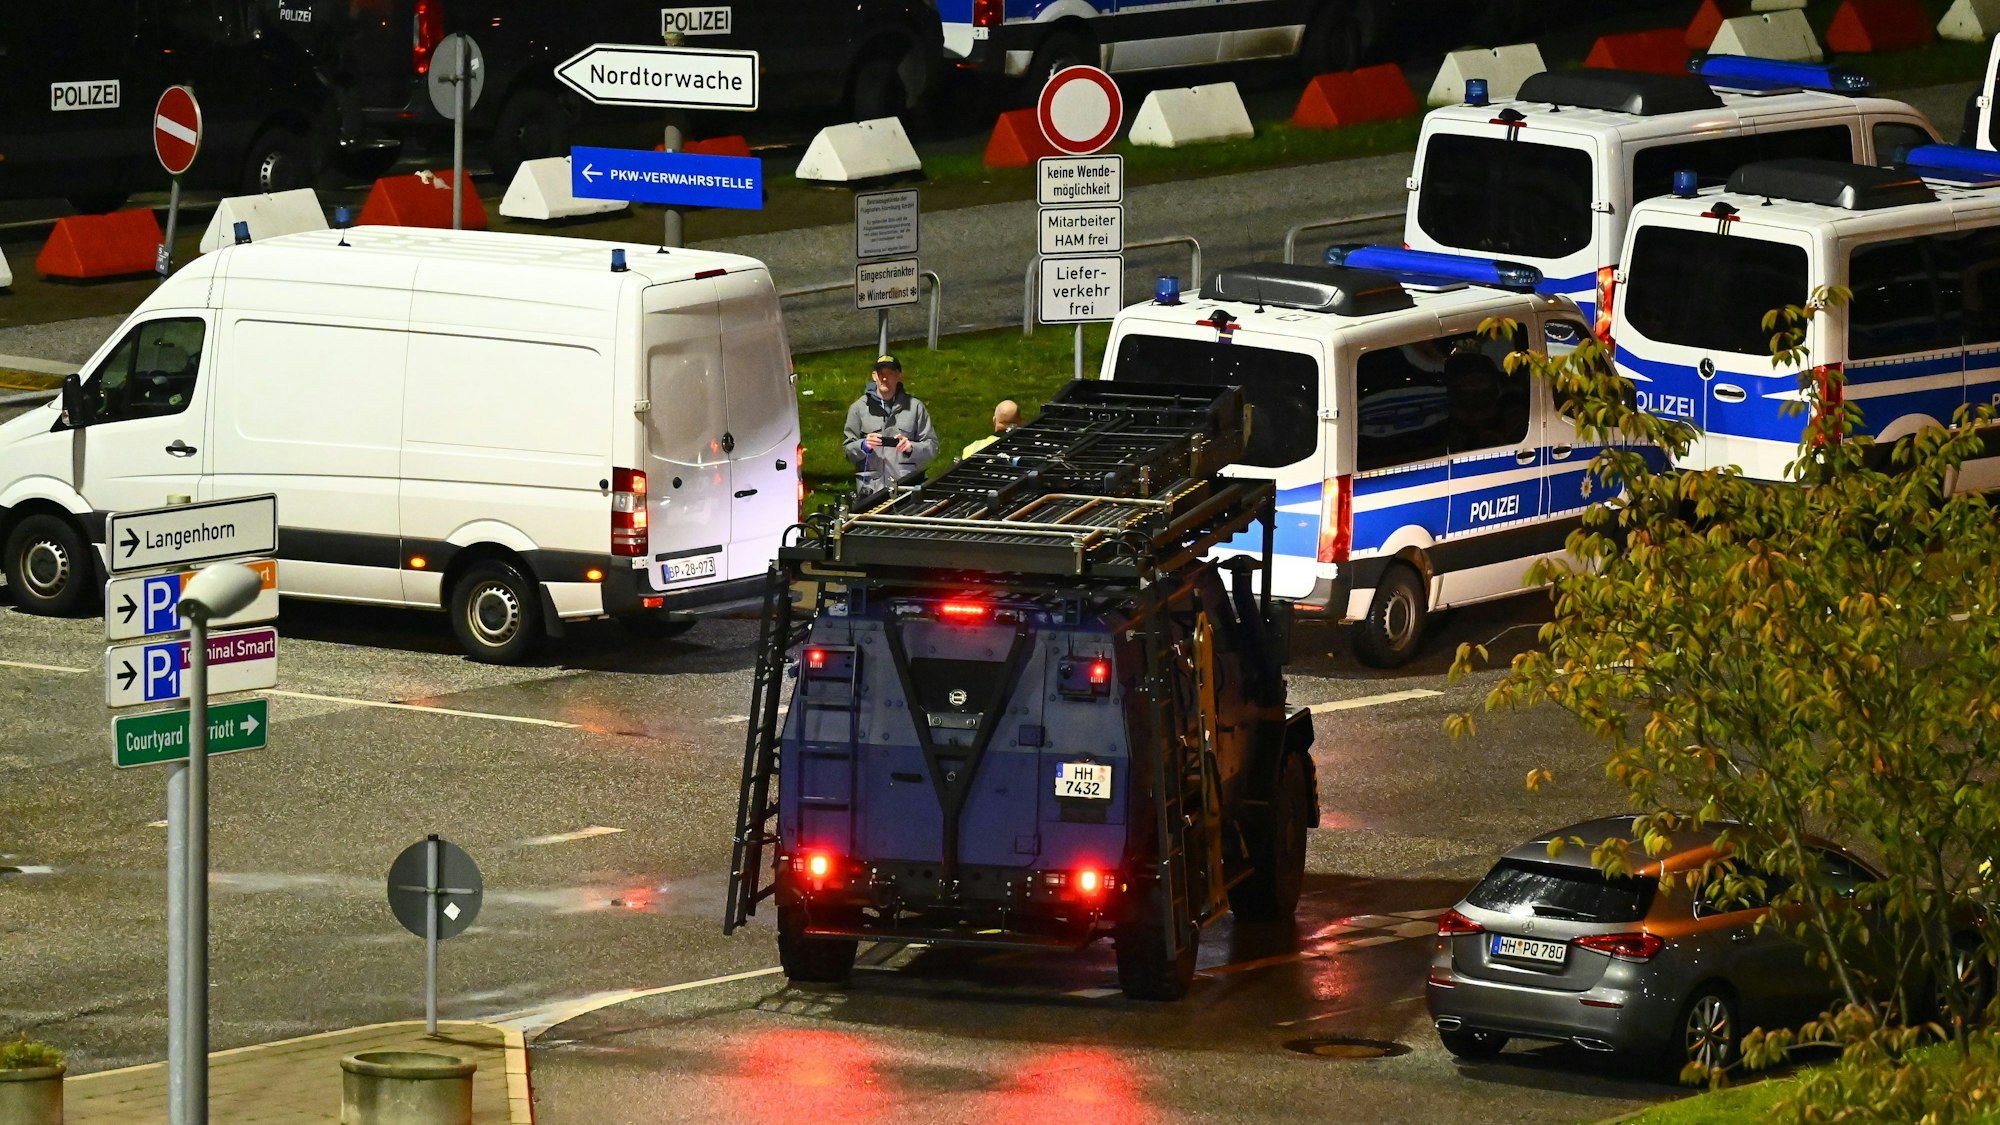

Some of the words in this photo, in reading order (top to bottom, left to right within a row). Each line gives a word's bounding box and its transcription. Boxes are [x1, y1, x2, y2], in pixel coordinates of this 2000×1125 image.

[279, 8, 312, 22] POLIZEI
[664, 10, 729, 31] POLIZEI
[590, 64, 743, 91] Nordtorwache
[53, 84, 117, 107] POLIZEI
[610, 169, 754, 190] PKW-VERWAHRSTELLE
[1047, 166, 1074, 179] keine
[1077, 164, 1116, 178] Wende-
[1053, 182, 1110, 199] möglichkeit
[1048, 214, 1116, 228] Mitarbeiter
[1055, 233, 1084, 247] HAM
[1088, 233, 1108, 246] frei
[860, 266, 915, 283] Eingeschränkter
[1056, 266, 1107, 280] Liefer-
[867, 287, 910, 302] Winterdienst
[1053, 283, 1110, 298] verkehr
[1069, 301, 1094, 315] frei
[1636, 390, 1695, 418] OLIZEI
[1469, 494, 1520, 523] POLIZEI
[146, 522, 236, 550] Langenhorn
[236, 637, 274, 657] Smart
[126, 725, 183, 753] Courtyard
[1074, 766, 1093, 780] HH
[1065, 780, 1100, 796] 7432
[1500, 938, 1517, 953] HH
[1522, 941, 1539, 957] PQ
[1541, 944, 1564, 960] 780
